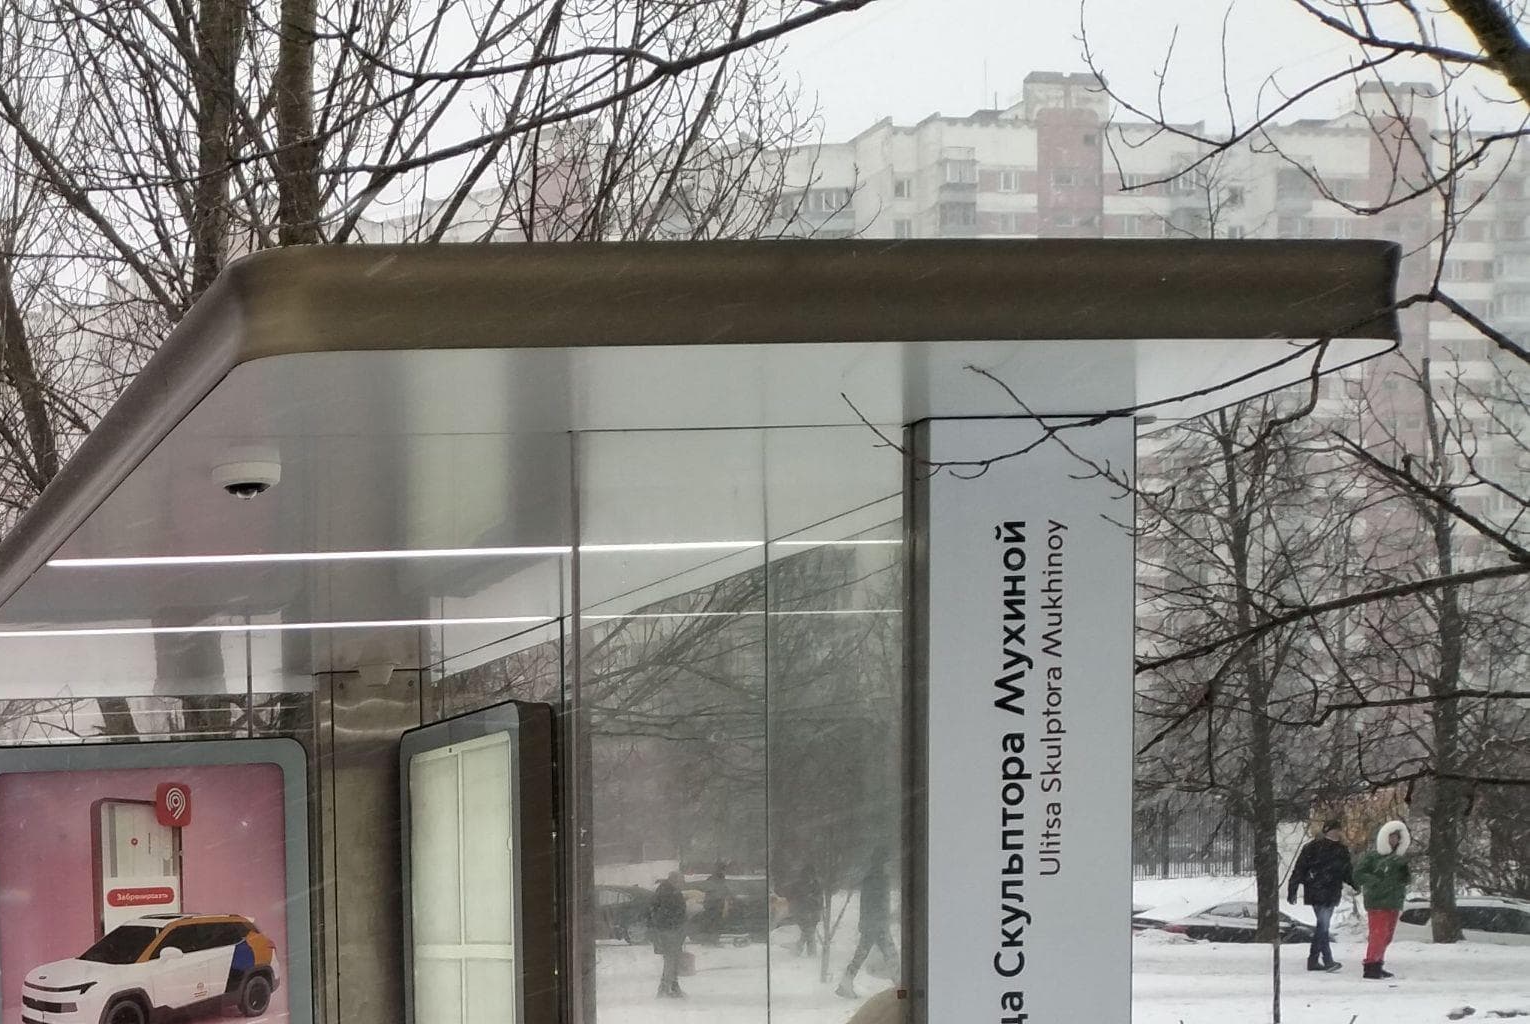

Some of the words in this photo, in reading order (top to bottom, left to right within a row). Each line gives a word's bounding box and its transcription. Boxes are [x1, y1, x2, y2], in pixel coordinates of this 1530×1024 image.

[993, 520, 1034, 716] Мухиной
[1040, 519, 1069, 658] Mukhinoy
[1039, 666, 1067, 793] Skulptora
[993, 732, 1033, 978] Скульптора
[1039, 802, 1062, 876] Ulitsa
